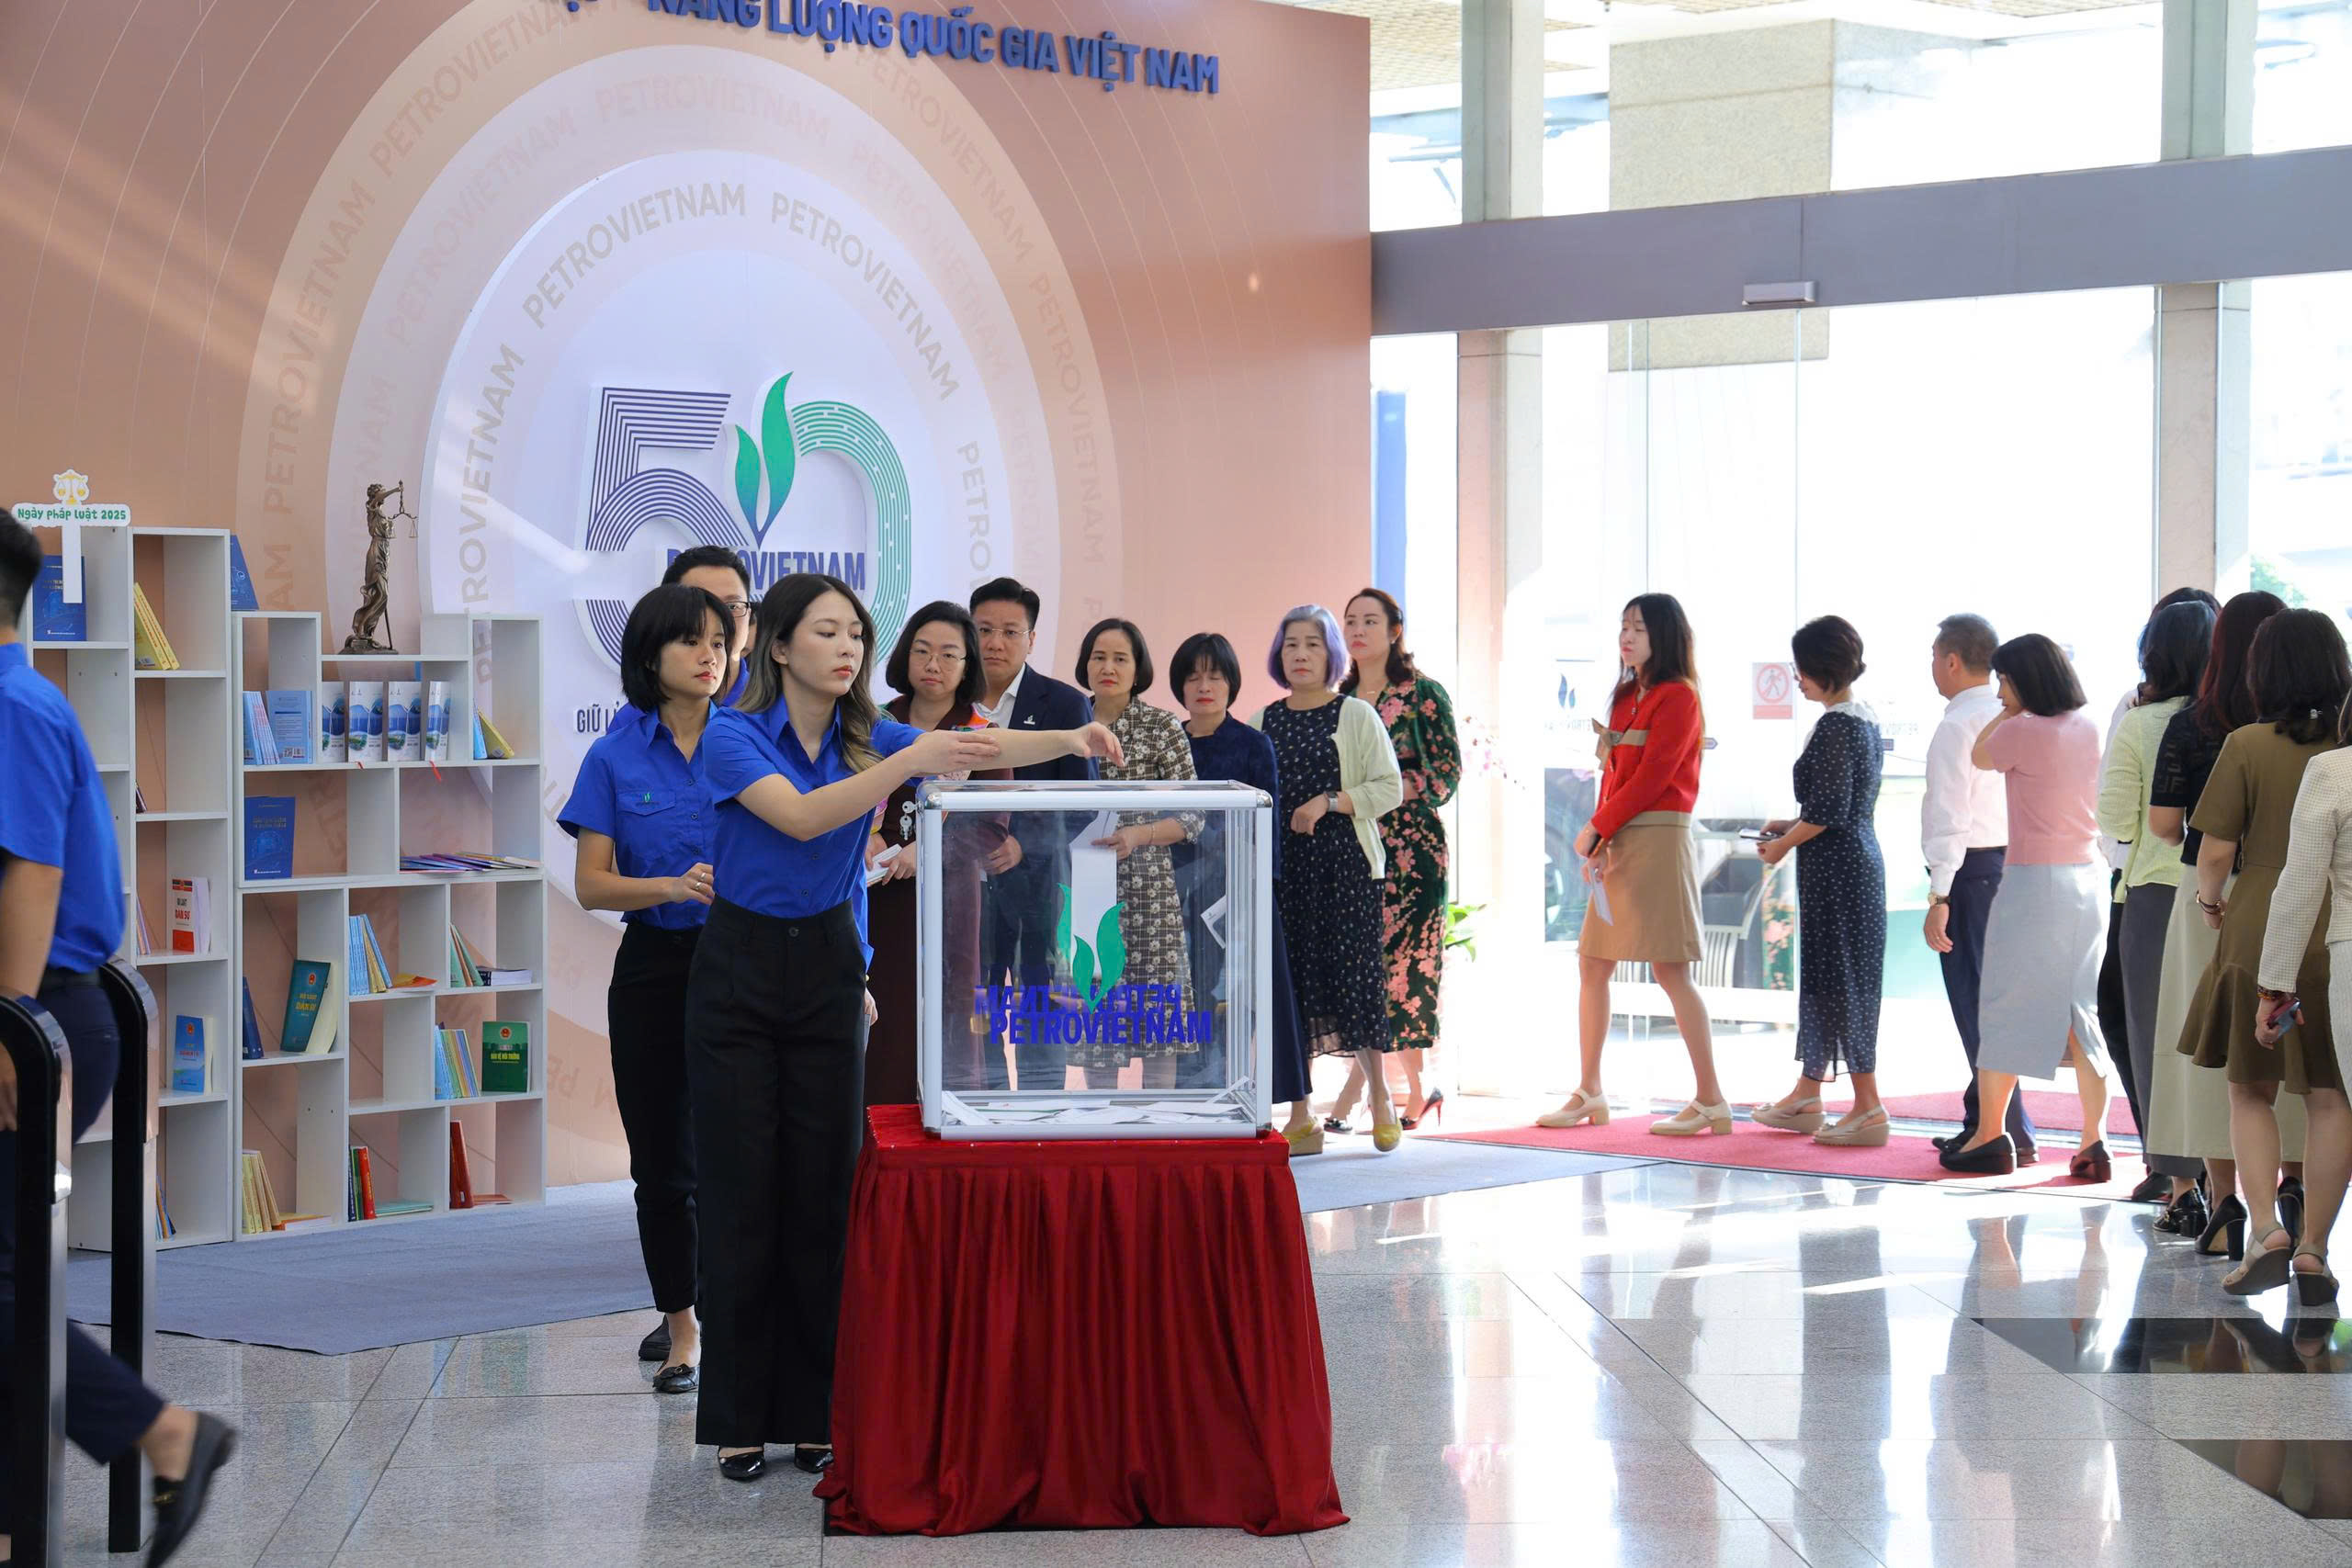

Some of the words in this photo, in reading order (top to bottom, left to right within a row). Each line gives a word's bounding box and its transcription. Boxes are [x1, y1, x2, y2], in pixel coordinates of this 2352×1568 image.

[899, 6, 994, 63] QUỐC
[1001, 27, 1060, 73] GIA
[1064, 30, 1140, 92] VIỆT
[1146, 48, 1219, 94] NAM
[522, 183, 746, 329] PETROVIETNAM
[771, 191, 960, 401] PETROVIETNAM
[264, 180, 376, 515] PETROVIETNAM
[17, 507, 43, 521] Ngày
[47, 507, 71, 520] pháp
[74, 507, 97, 522] luật
[101, 510, 126, 520] 2025
[577, 704, 600, 732] GIỮ
[989, 1011, 1212, 1044] PETROVIETNAM
